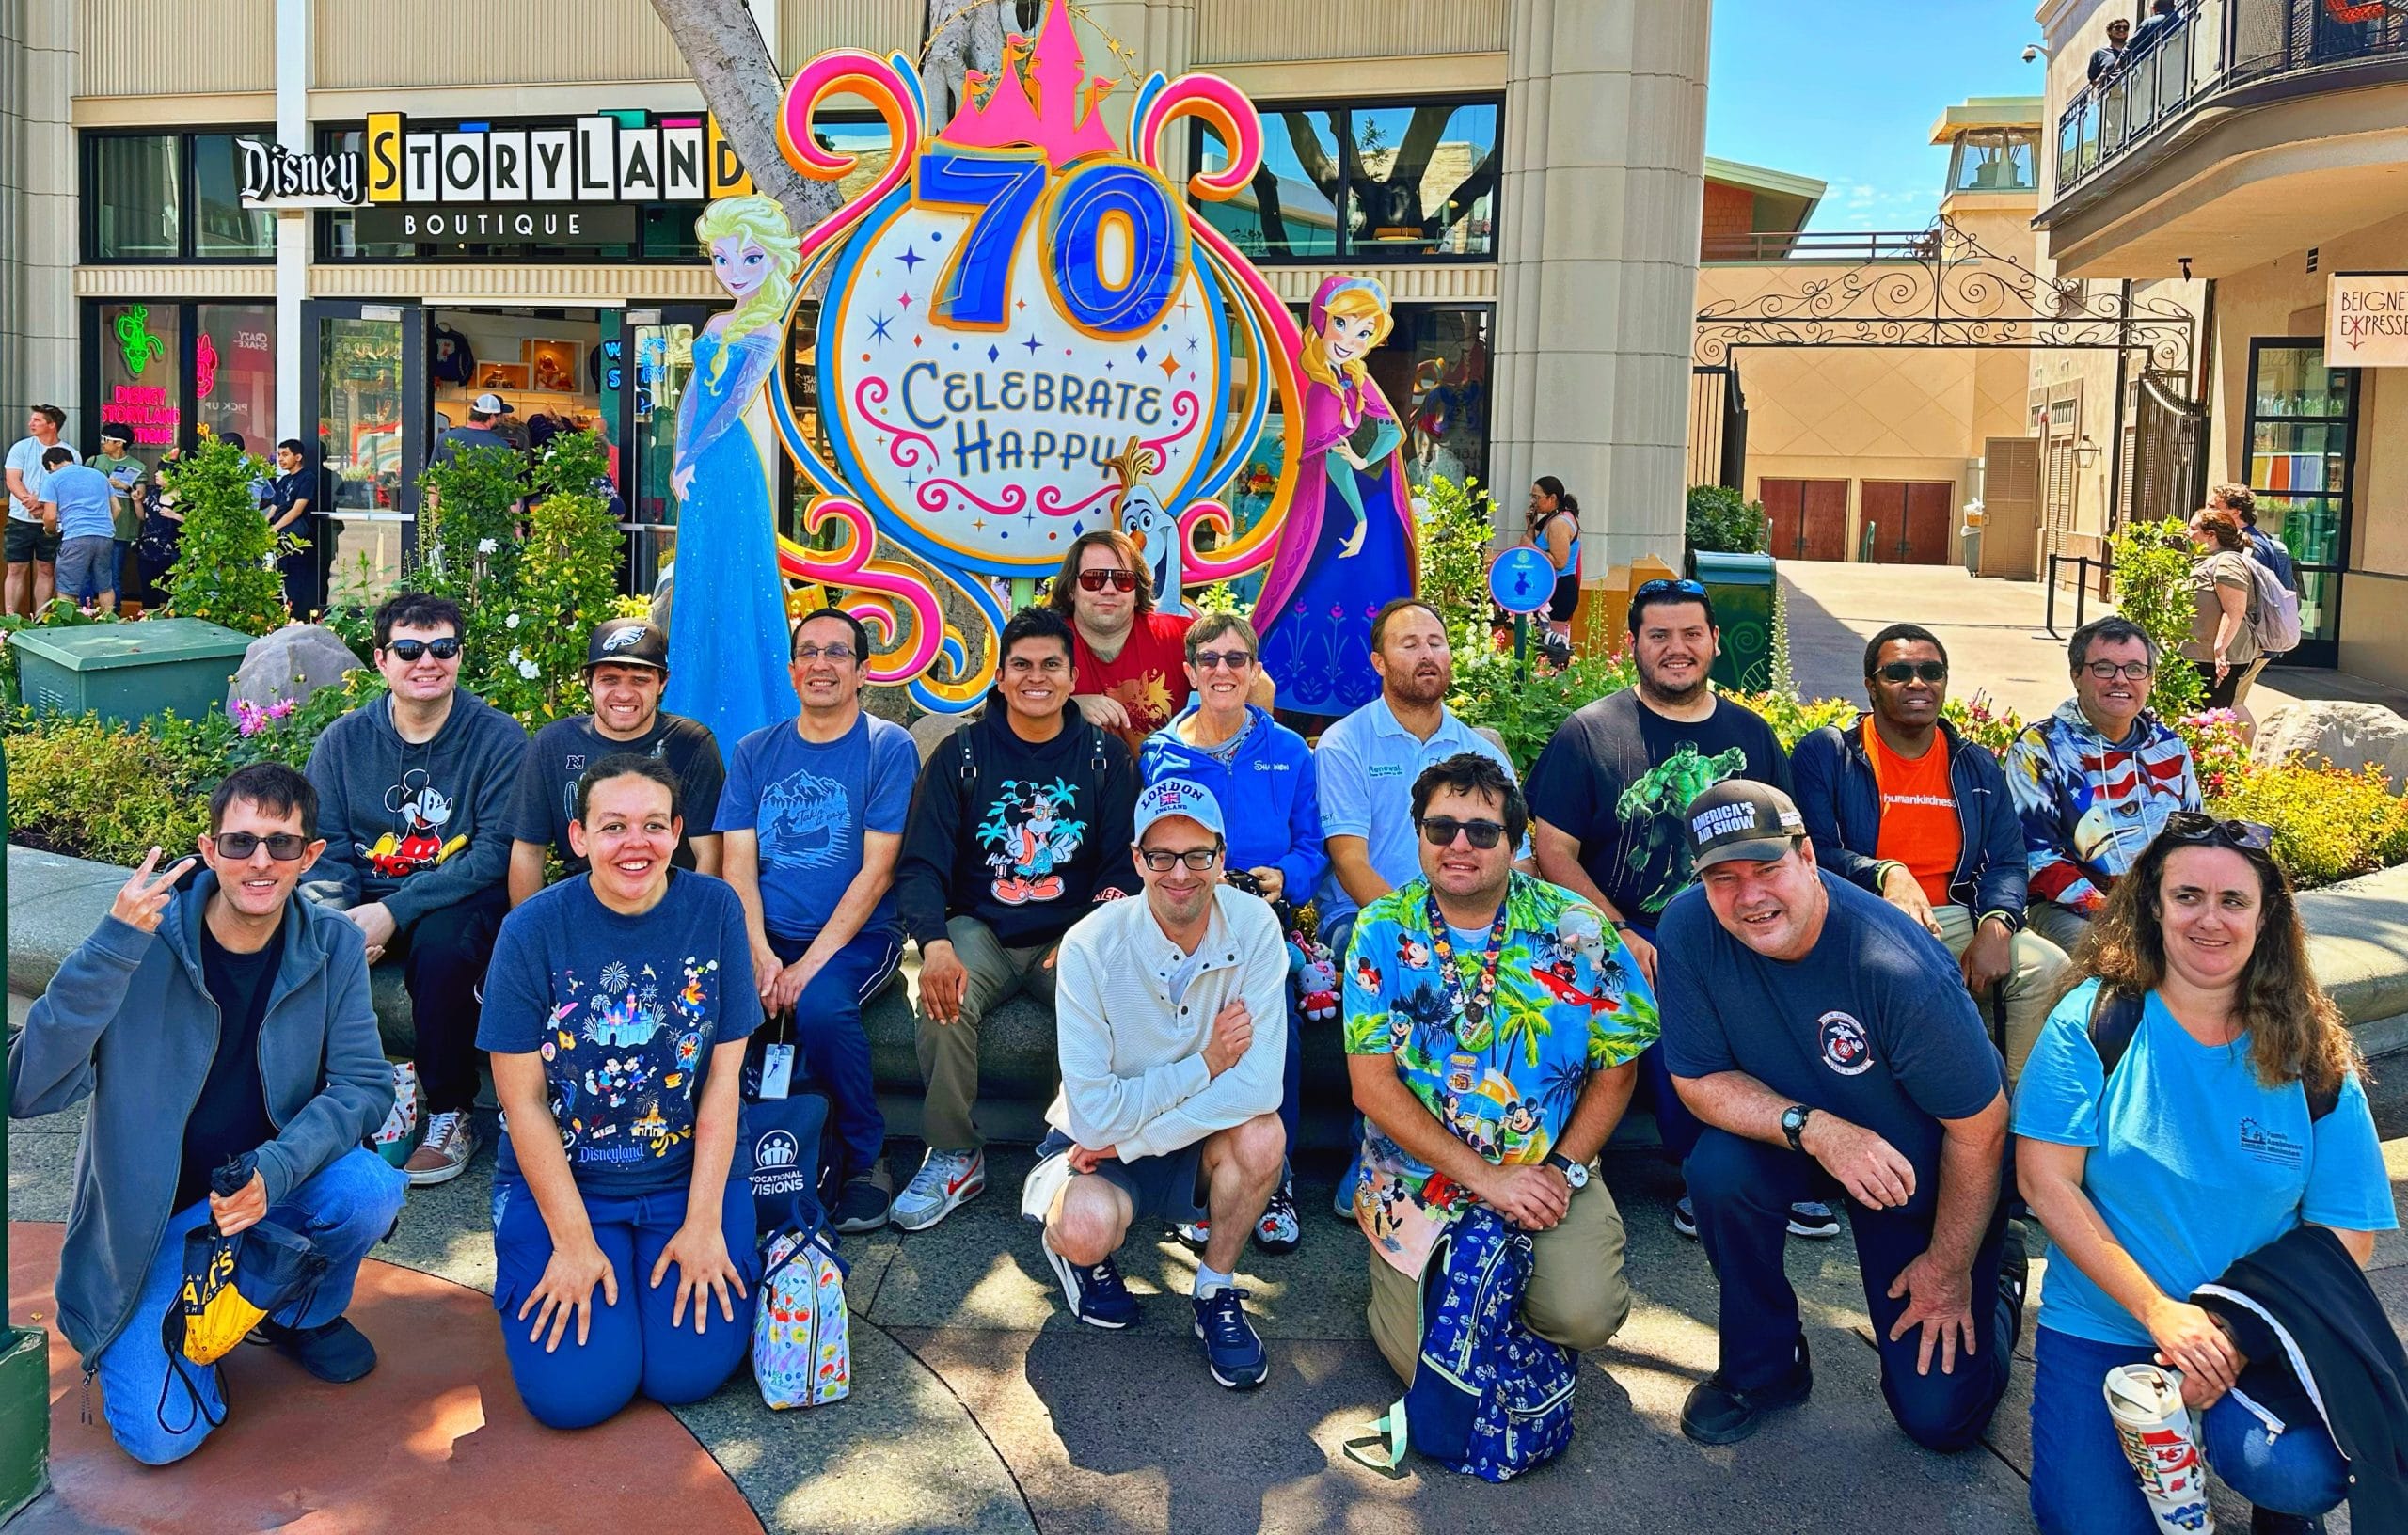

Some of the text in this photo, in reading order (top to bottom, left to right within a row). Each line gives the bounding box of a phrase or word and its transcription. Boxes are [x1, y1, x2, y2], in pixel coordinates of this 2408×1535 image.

[234, 129, 747, 205] Disney STORYLAND
[404, 214, 581, 236] BOUTIQUE
[912, 137, 1191, 341] 70
[2341, 291, 2408, 312] BEIGNE
[115, 385, 167, 405] DISNEY
[901, 361, 1163, 430] CELEBRATE
[952, 419, 1117, 480] HAPPY
[1140, 781, 1205, 811] LONDON
[1155, 803, 1188, 815] ENGLAND
[1692, 801, 1756, 832] AMERICA'S
[1698, 815, 1756, 846] AIR SHOW
[578, 1141, 646, 1164] Disneyland
